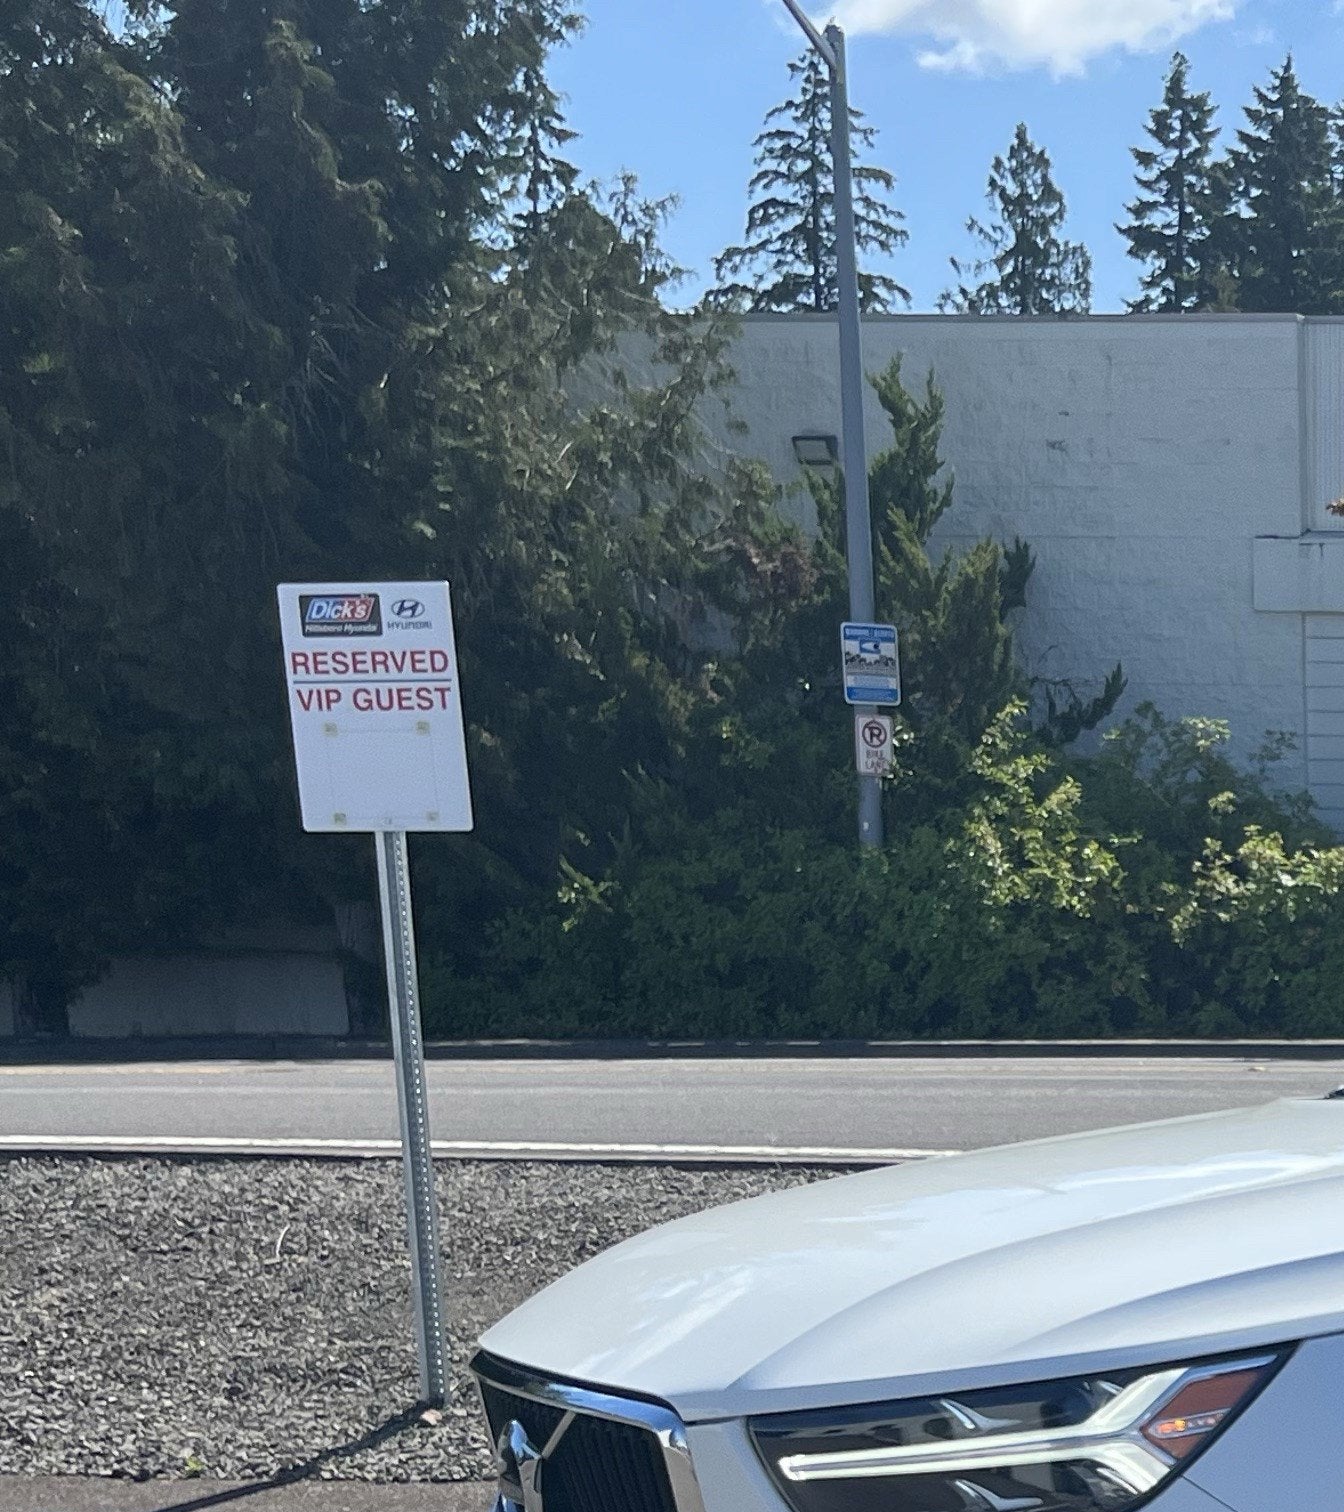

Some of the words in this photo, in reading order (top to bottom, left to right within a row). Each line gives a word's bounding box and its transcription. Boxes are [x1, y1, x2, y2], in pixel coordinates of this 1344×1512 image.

[291, 650, 449, 675] RESERVED
[296, 689, 342, 712] VIP
[352, 687, 451, 711] GUEST
